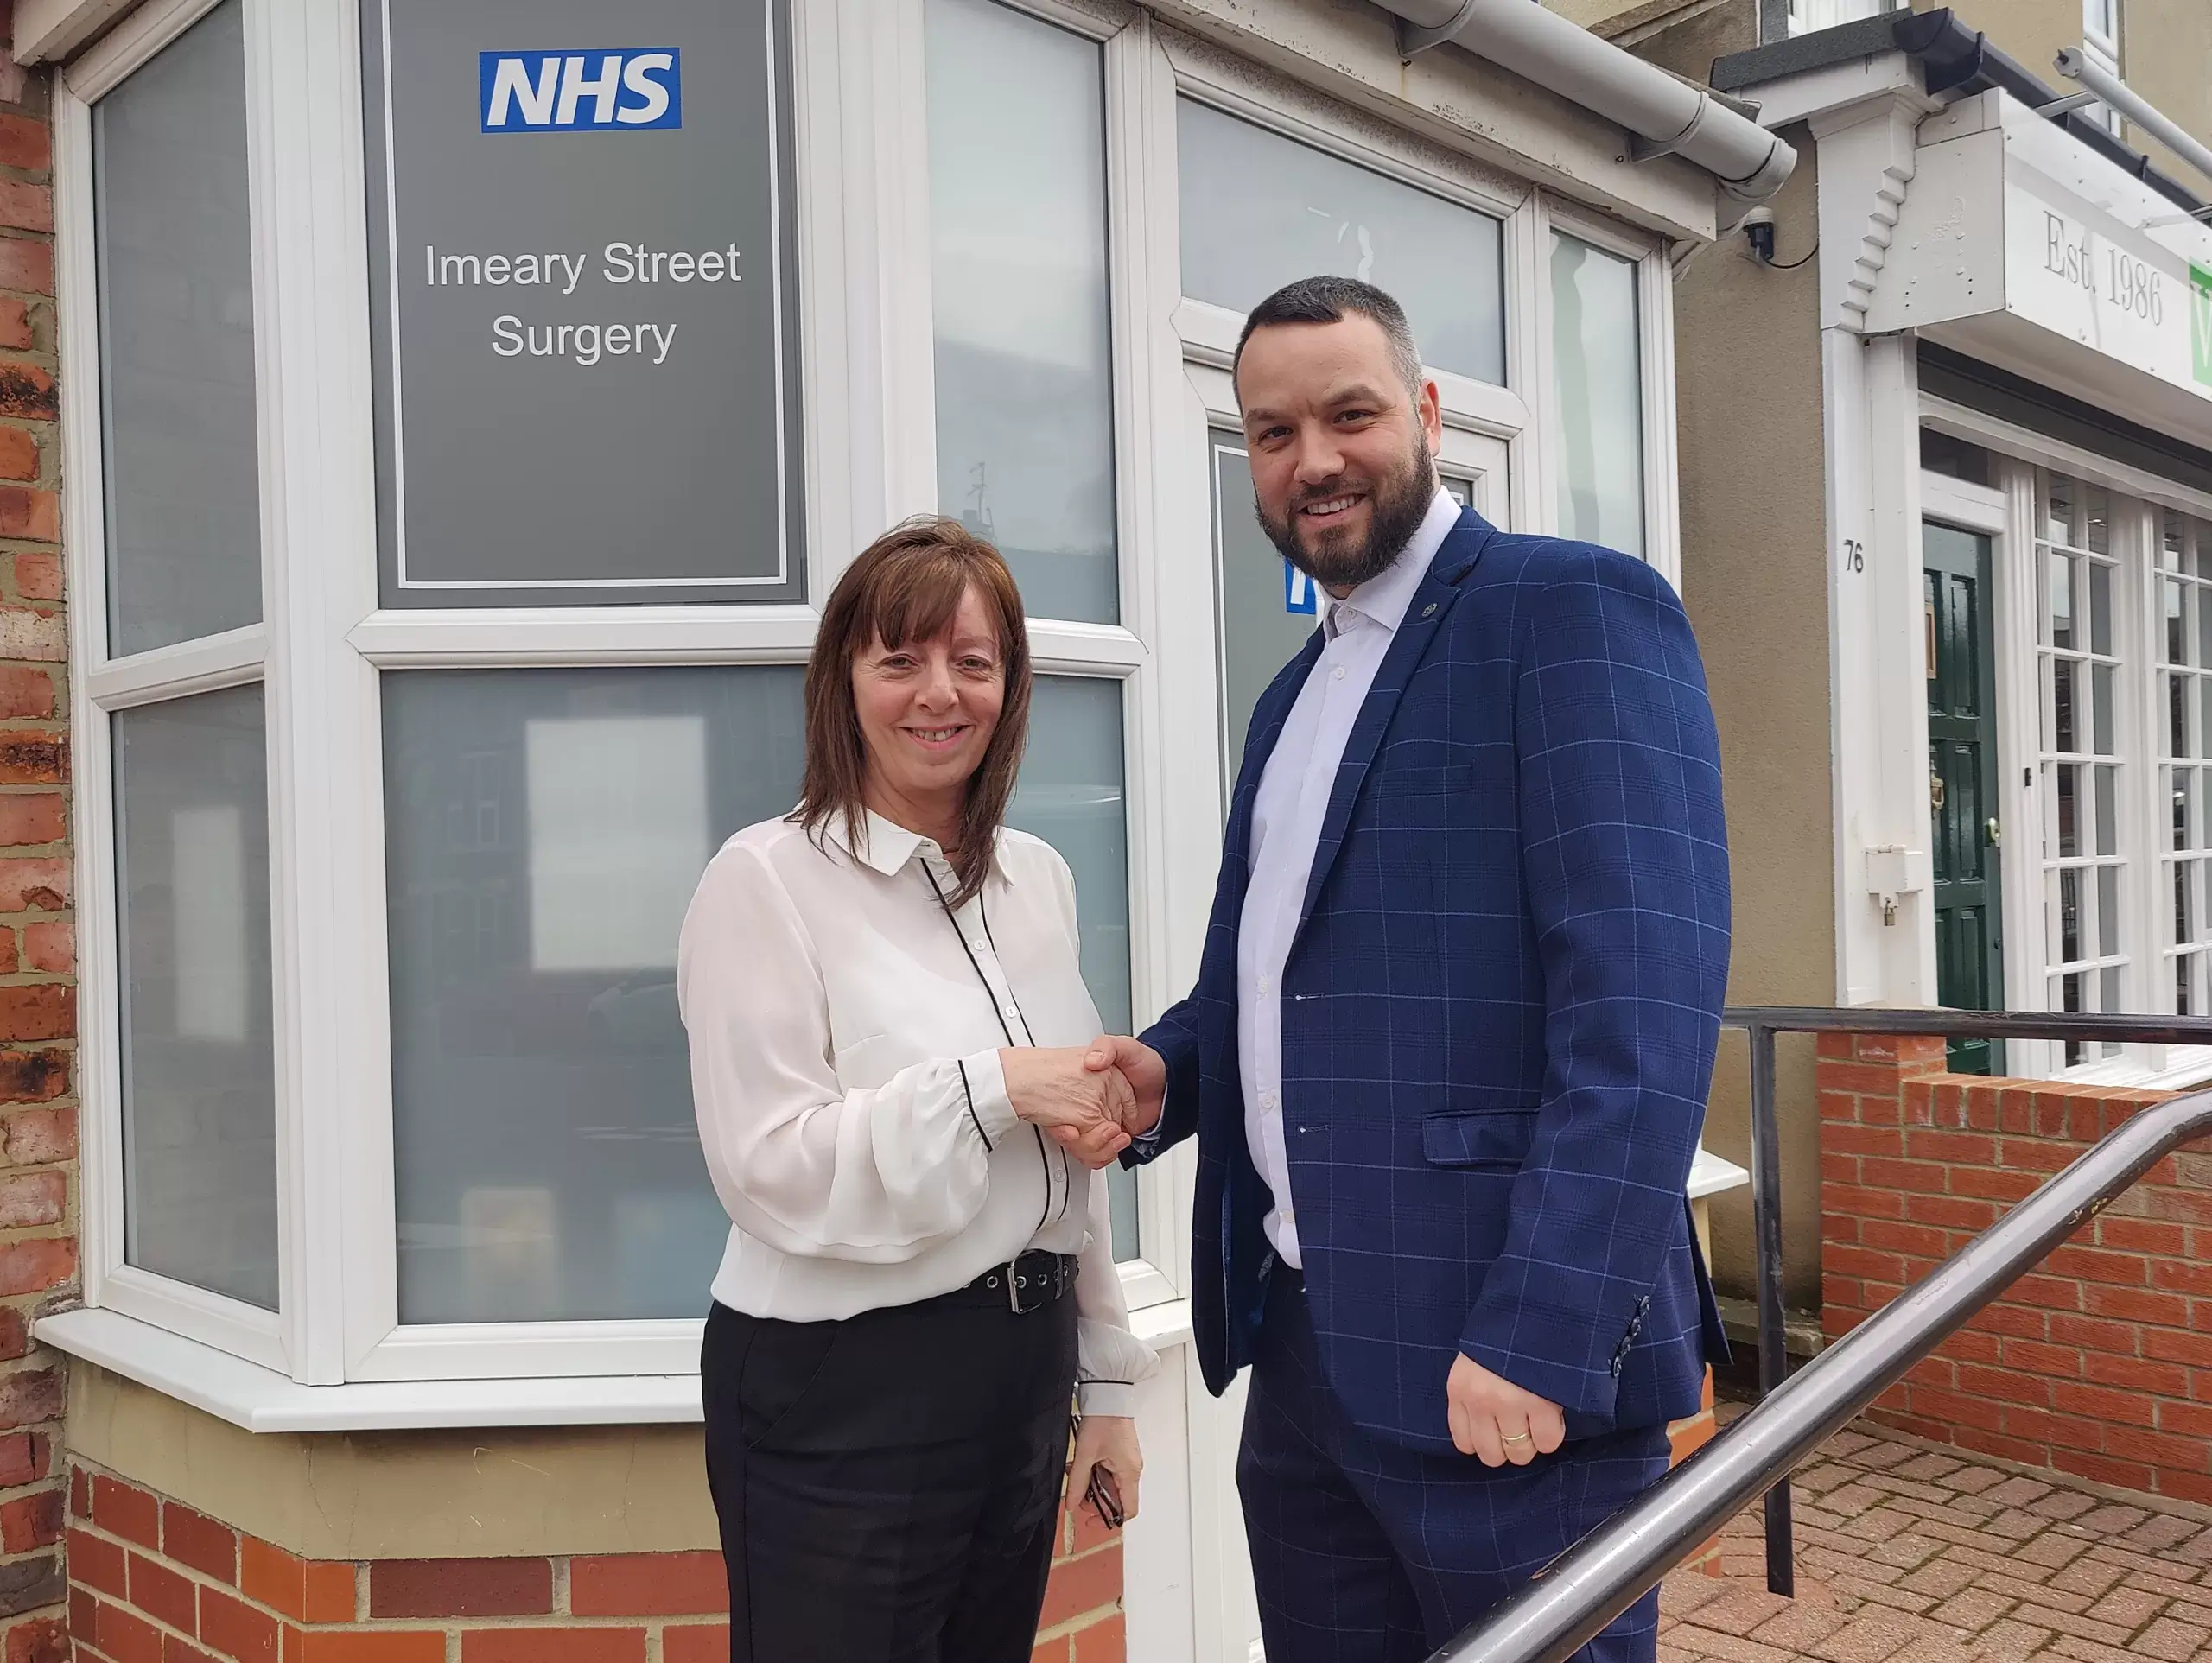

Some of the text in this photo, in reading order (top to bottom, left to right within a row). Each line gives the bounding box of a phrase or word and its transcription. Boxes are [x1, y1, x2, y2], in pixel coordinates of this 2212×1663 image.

[486, 53, 673, 126] NHS
[426, 243, 741, 294] Imeary Street
[2044, 210, 2096, 294] Est.
[2107, 249, 2161, 326] 1986
[492, 315, 677, 365] Surgery
[1843, 539, 1864, 574] 76
